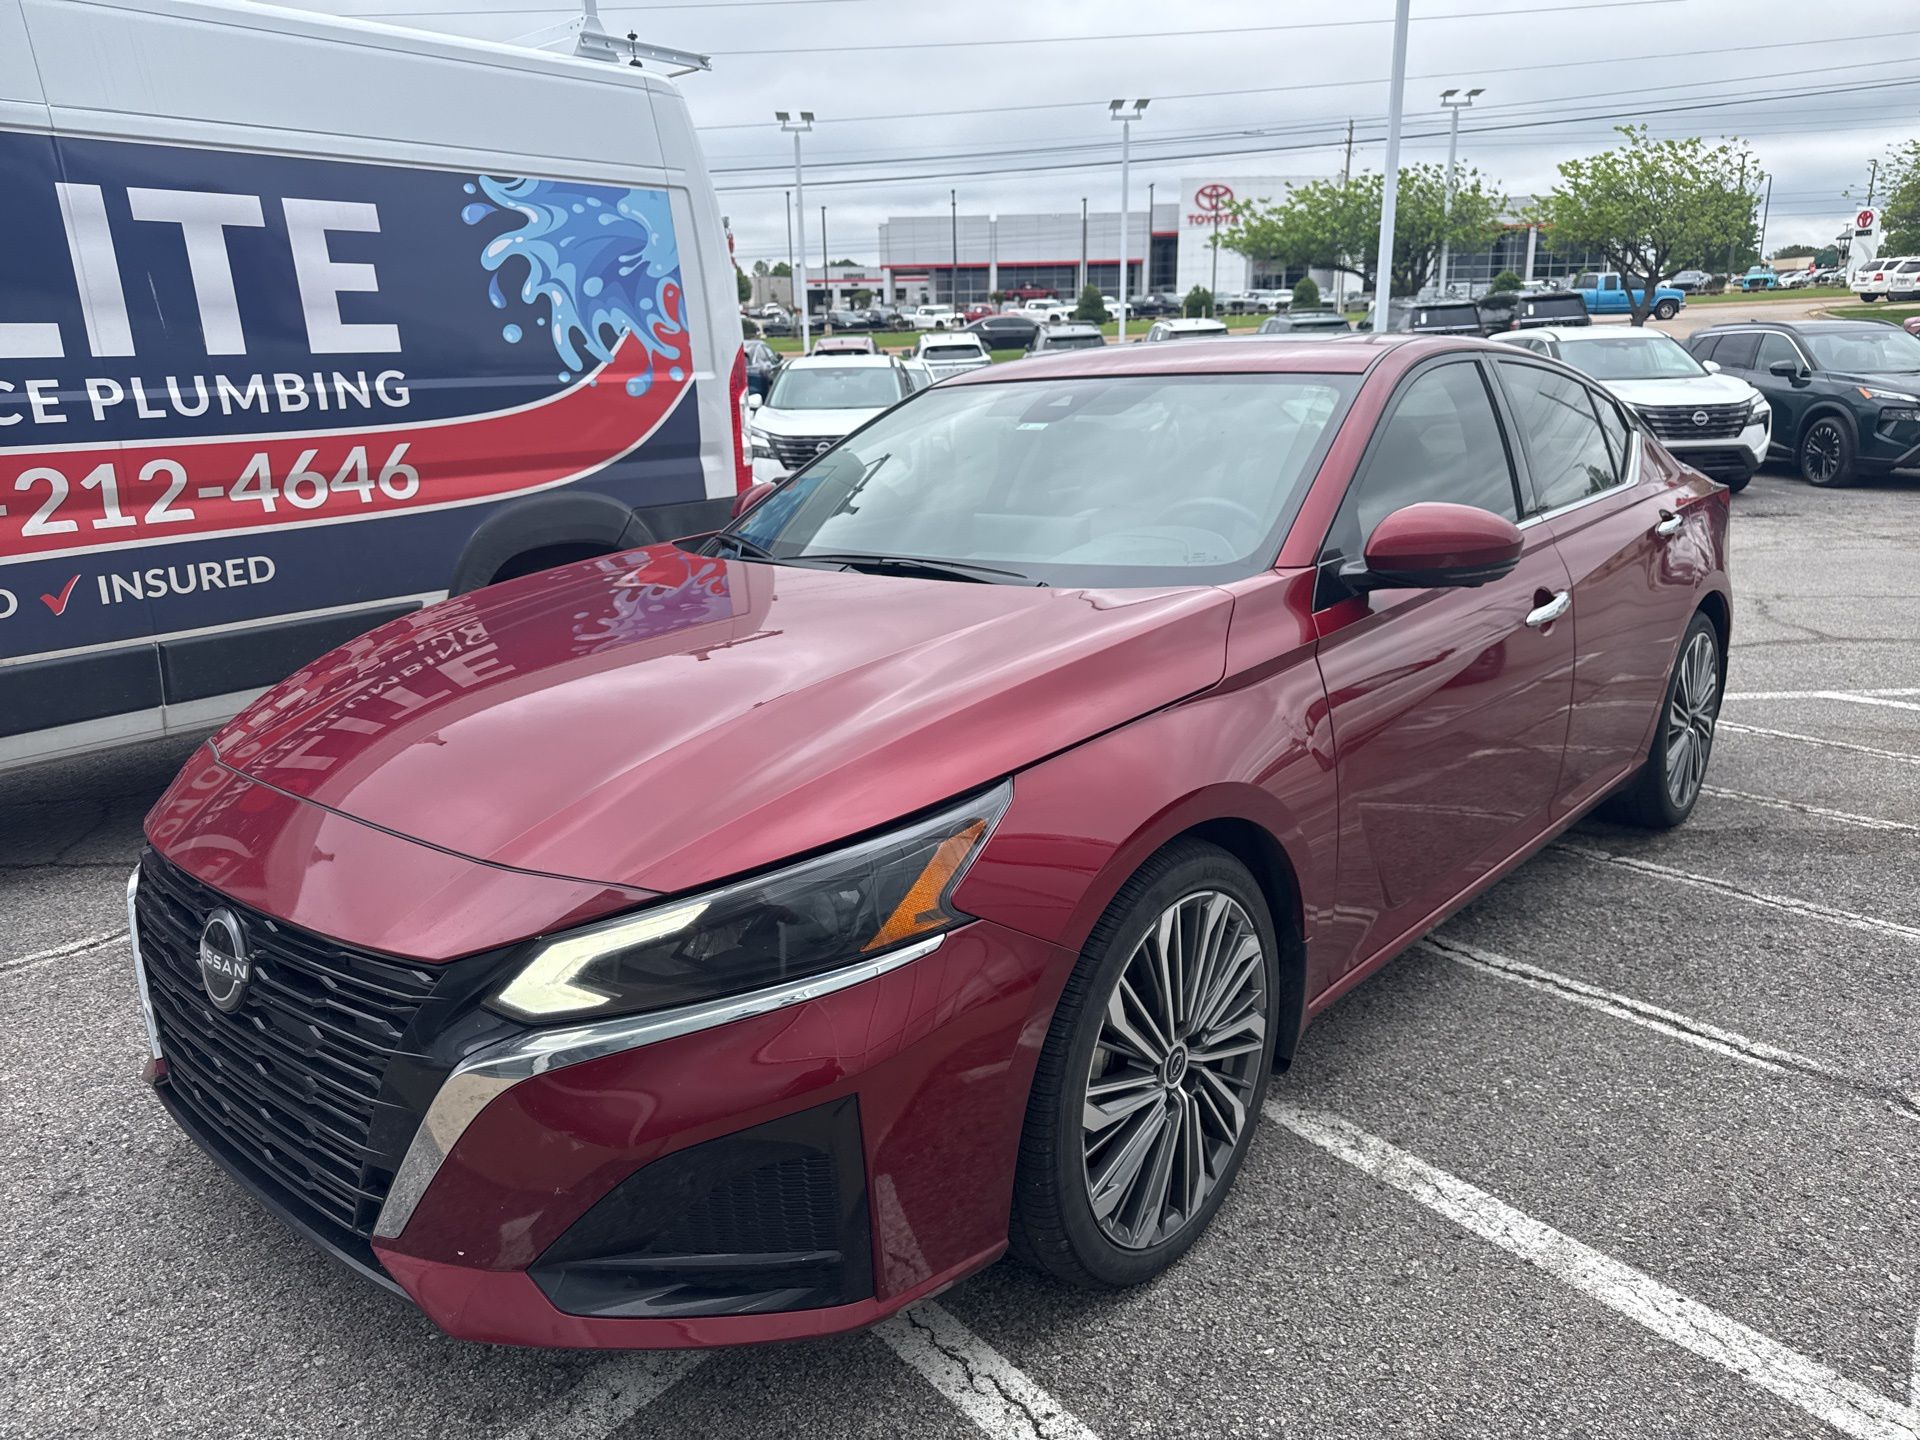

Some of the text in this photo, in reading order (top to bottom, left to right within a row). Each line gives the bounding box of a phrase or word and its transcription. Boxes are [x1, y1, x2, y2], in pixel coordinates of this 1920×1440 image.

[1187, 214, 1239, 225] TOYOTA
[85, 370, 411, 421] PLUMBING
[98, 555, 276, 605] INSURED
